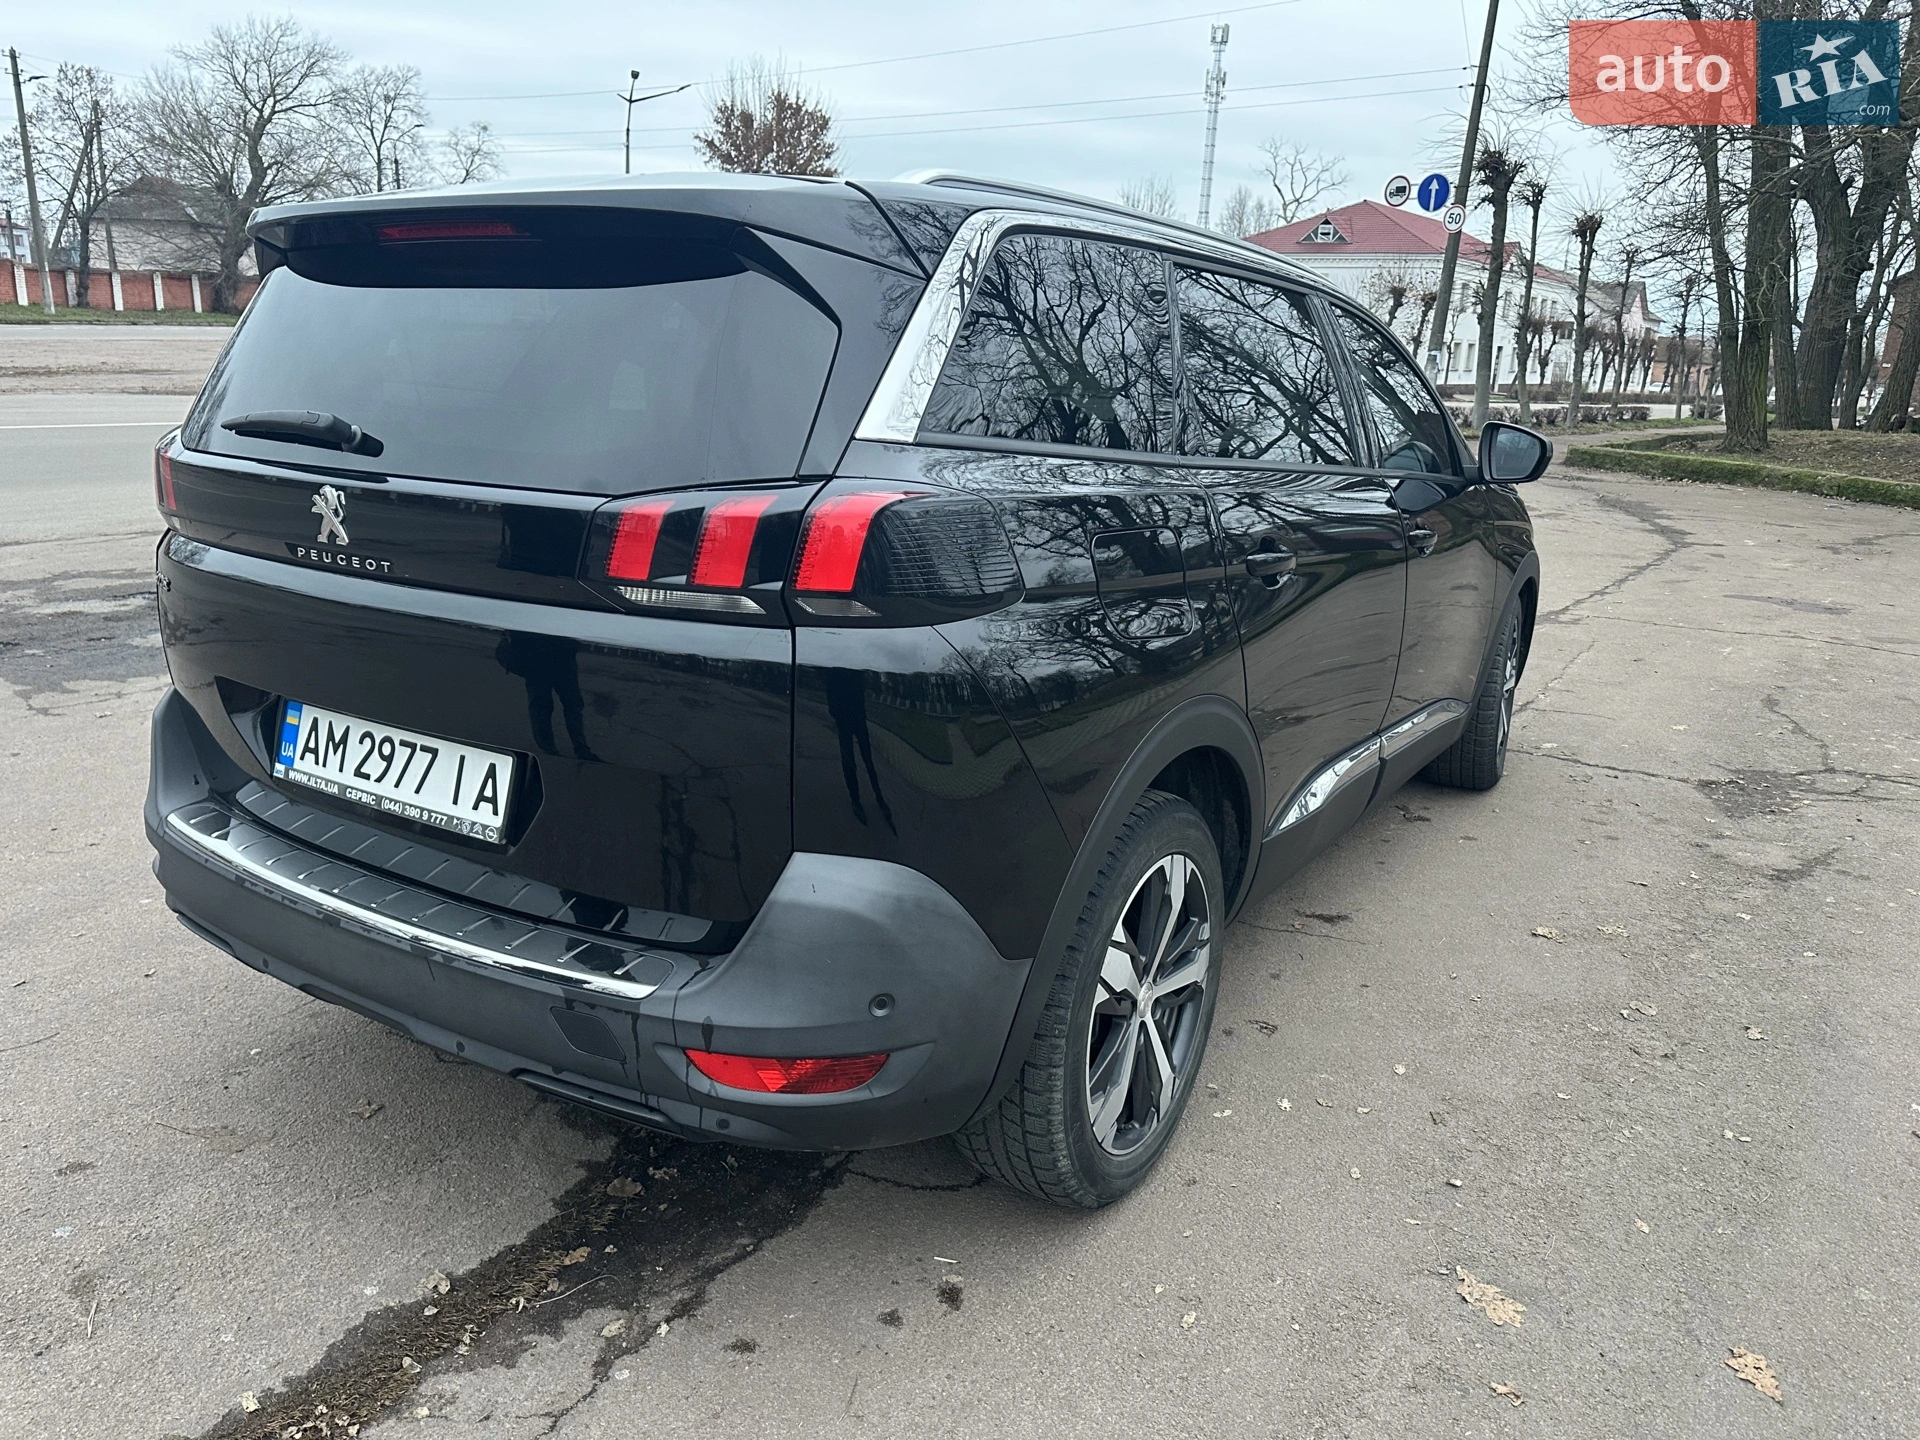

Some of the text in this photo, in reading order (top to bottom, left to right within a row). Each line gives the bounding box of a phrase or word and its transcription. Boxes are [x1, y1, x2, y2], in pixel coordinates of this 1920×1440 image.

[1447, 212, 1462, 225] 50
[297, 547, 391, 573] PEUGEOT
[281, 741, 294, 759] UA
[299, 716, 499, 816] AM 2977 IA
[288, 769, 339, 795] WWW.ILTA.UA
[381, 797, 403, 814] (044)
[404, 805, 421, 818] 390
[421, 810, 429, 821] 9
[430, 813, 448, 826] 777
